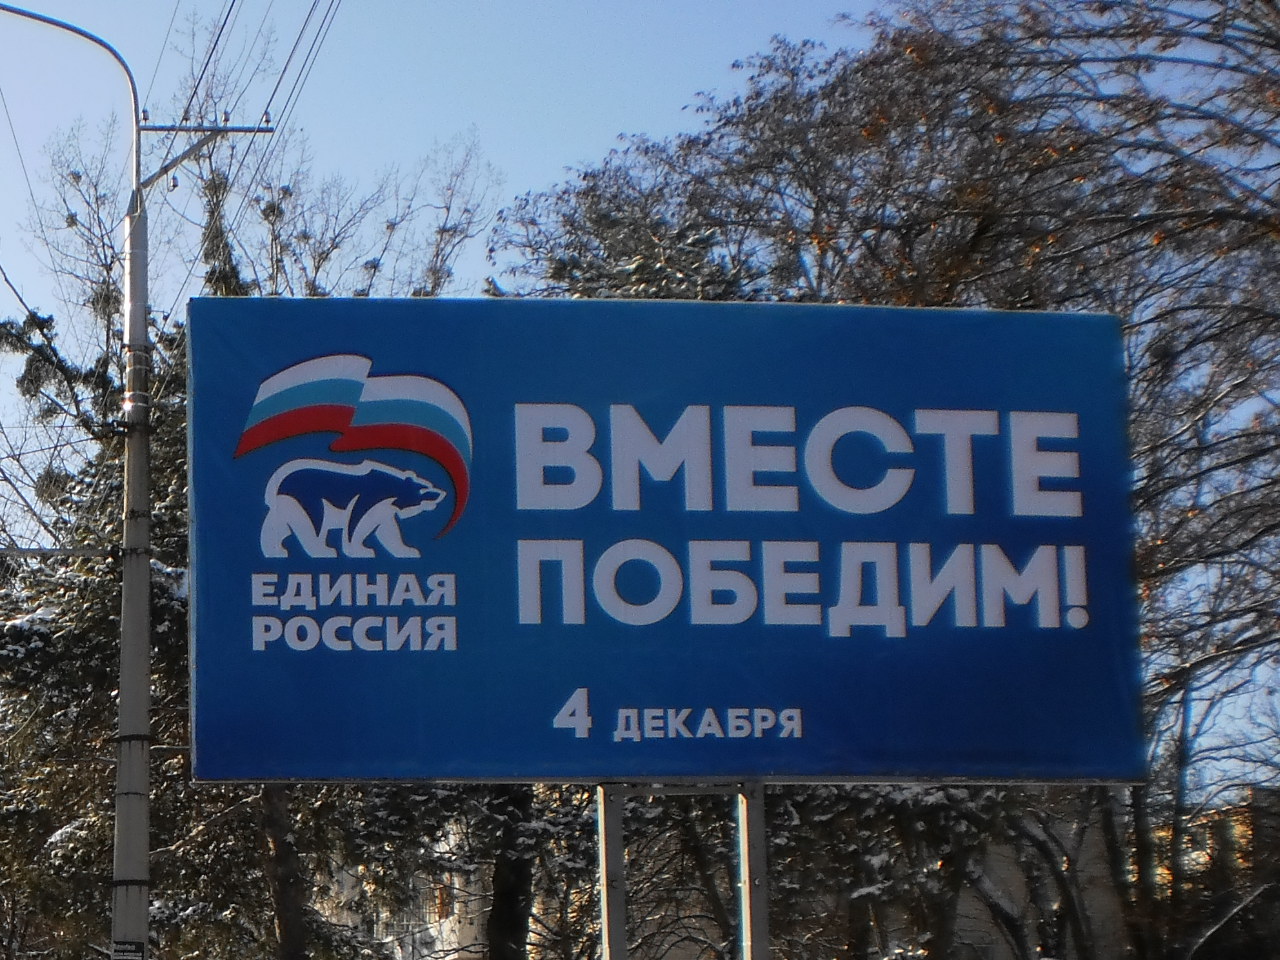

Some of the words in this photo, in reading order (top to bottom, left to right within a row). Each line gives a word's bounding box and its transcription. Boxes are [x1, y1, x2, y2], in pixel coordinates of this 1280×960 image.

[514, 402, 1083, 518] ВМЕСТЕ
[251, 573, 457, 611] ЕДИНАЯ
[517, 538, 1090, 639] ПОБЕДИМ!
[252, 615, 457, 652] РОССИЯ
[552, 687, 593, 739] 4
[613, 707, 803, 743] ДЕКАБРЯ
